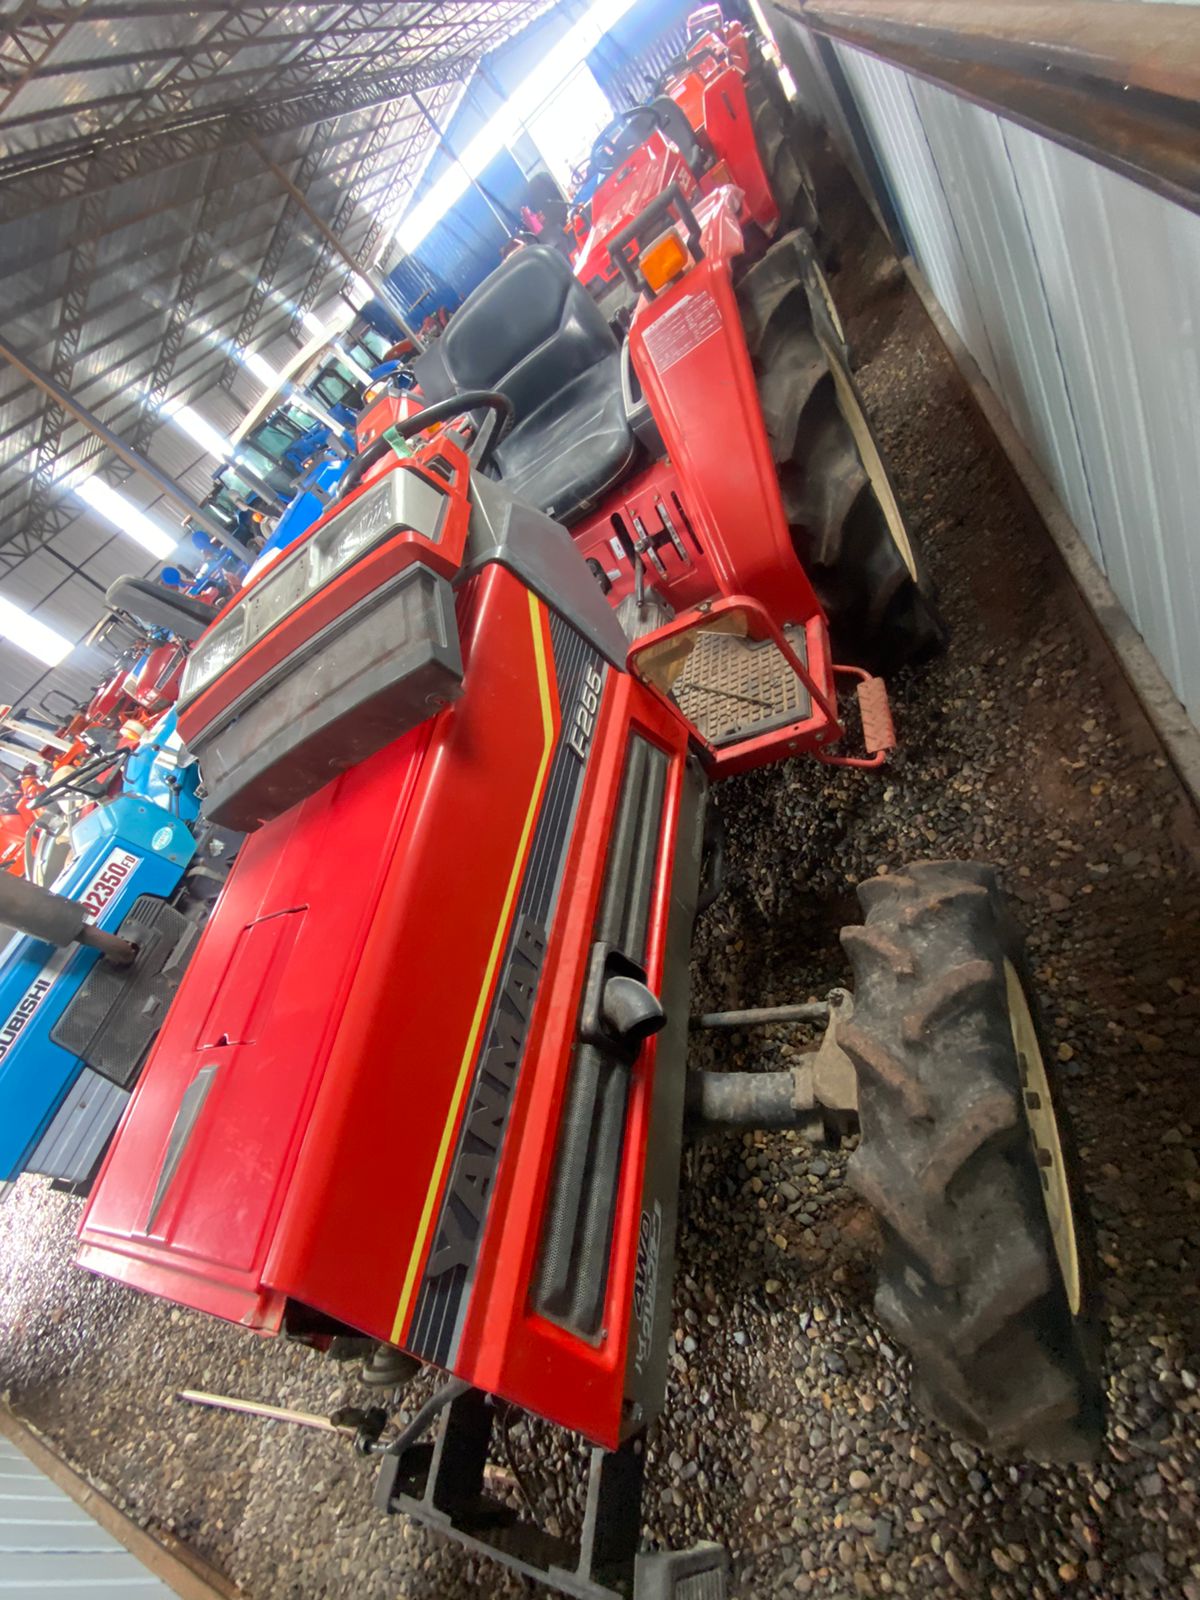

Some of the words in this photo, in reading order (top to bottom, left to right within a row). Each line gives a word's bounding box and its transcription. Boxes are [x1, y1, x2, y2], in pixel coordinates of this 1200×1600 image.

[570, 665, 602, 758] F255
[427, 912, 550, 1277] YANMAR
[635, 1210, 650, 1320] 4WD
